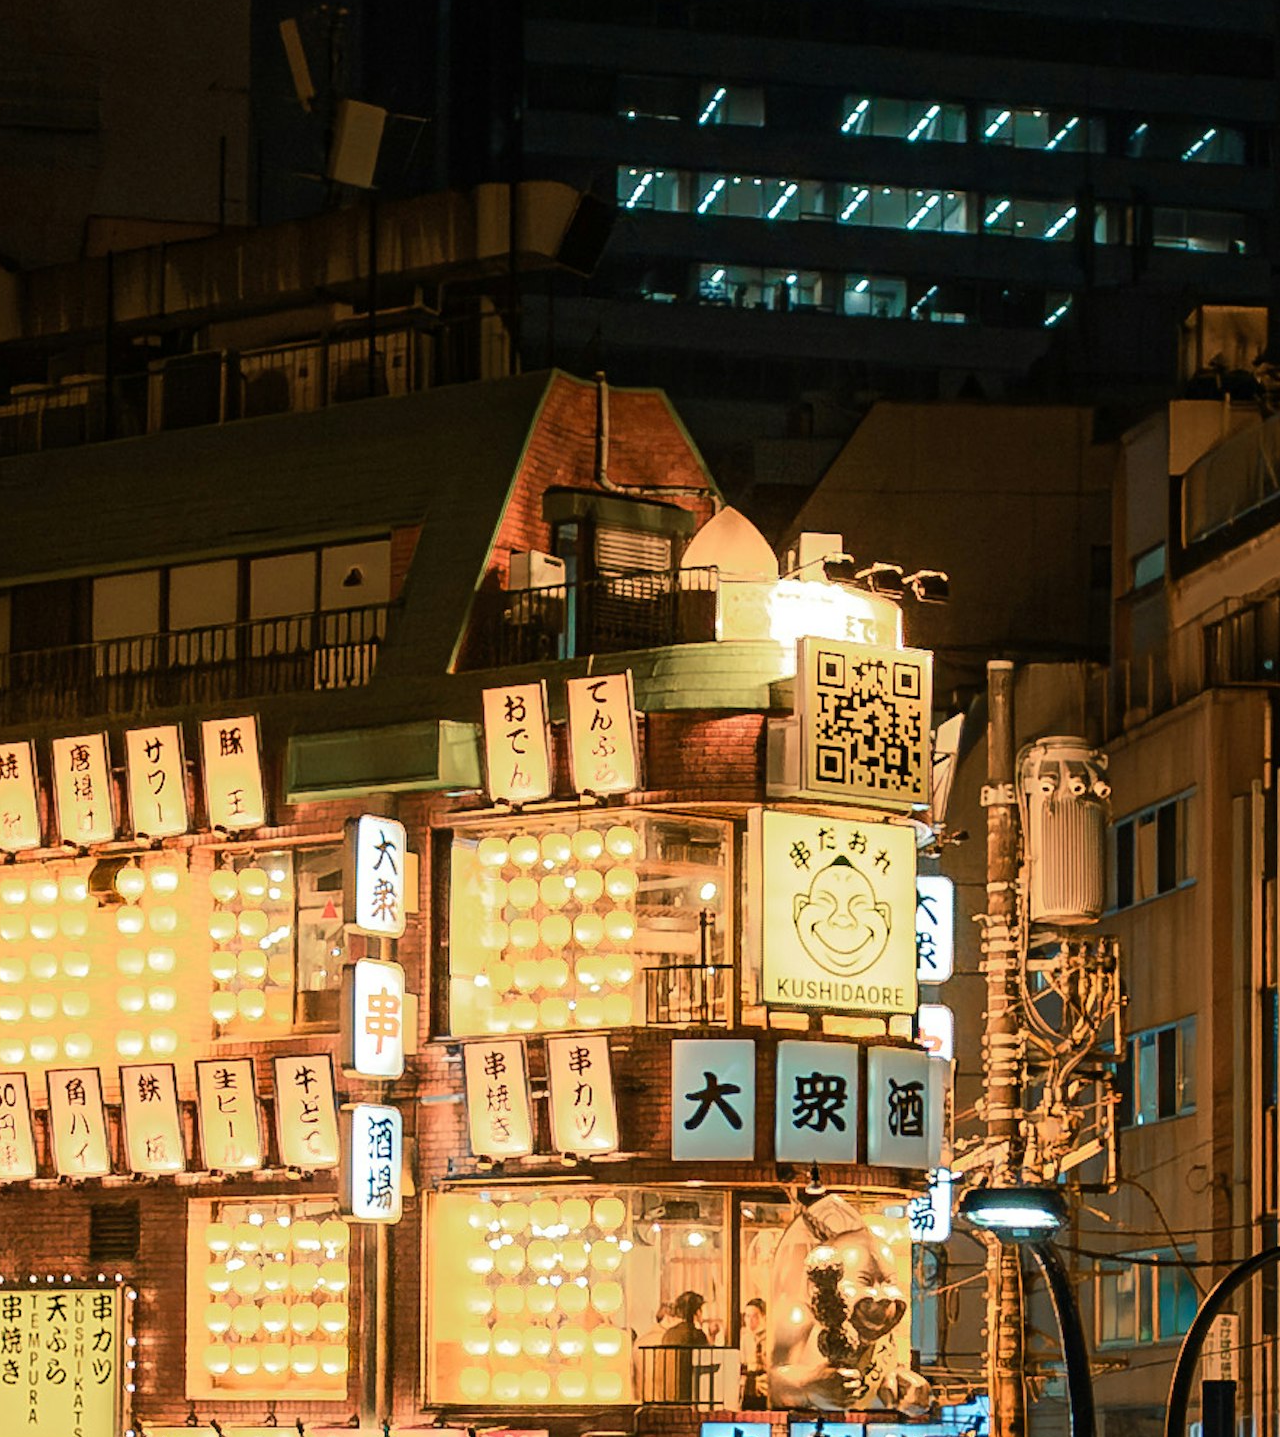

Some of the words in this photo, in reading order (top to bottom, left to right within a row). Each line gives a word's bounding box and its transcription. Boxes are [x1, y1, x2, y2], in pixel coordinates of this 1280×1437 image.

[143, 736, 167, 823] サワー
[218, 727, 246, 816] 豚王
[504, 695, 531, 788] おでん
[371, 829, 398, 922] 大衆
[788, 826, 892, 876] 串だおれ
[365, 986, 401, 1056] 串
[777, 977, 904, 1007] KUSHIDAORE
[64, 1076, 90, 1167] 角ハイ
[483, 1051, 513, 1143] 串焼き
[568, 1045, 597, 1141] 串カツ
[366, 1115, 394, 1210] 酒場
[1, 1294, 22, 1385] 串焼き
[27, 1295, 40, 1425] TEMPURA
[92, 1293, 113, 1385] 串カツ
